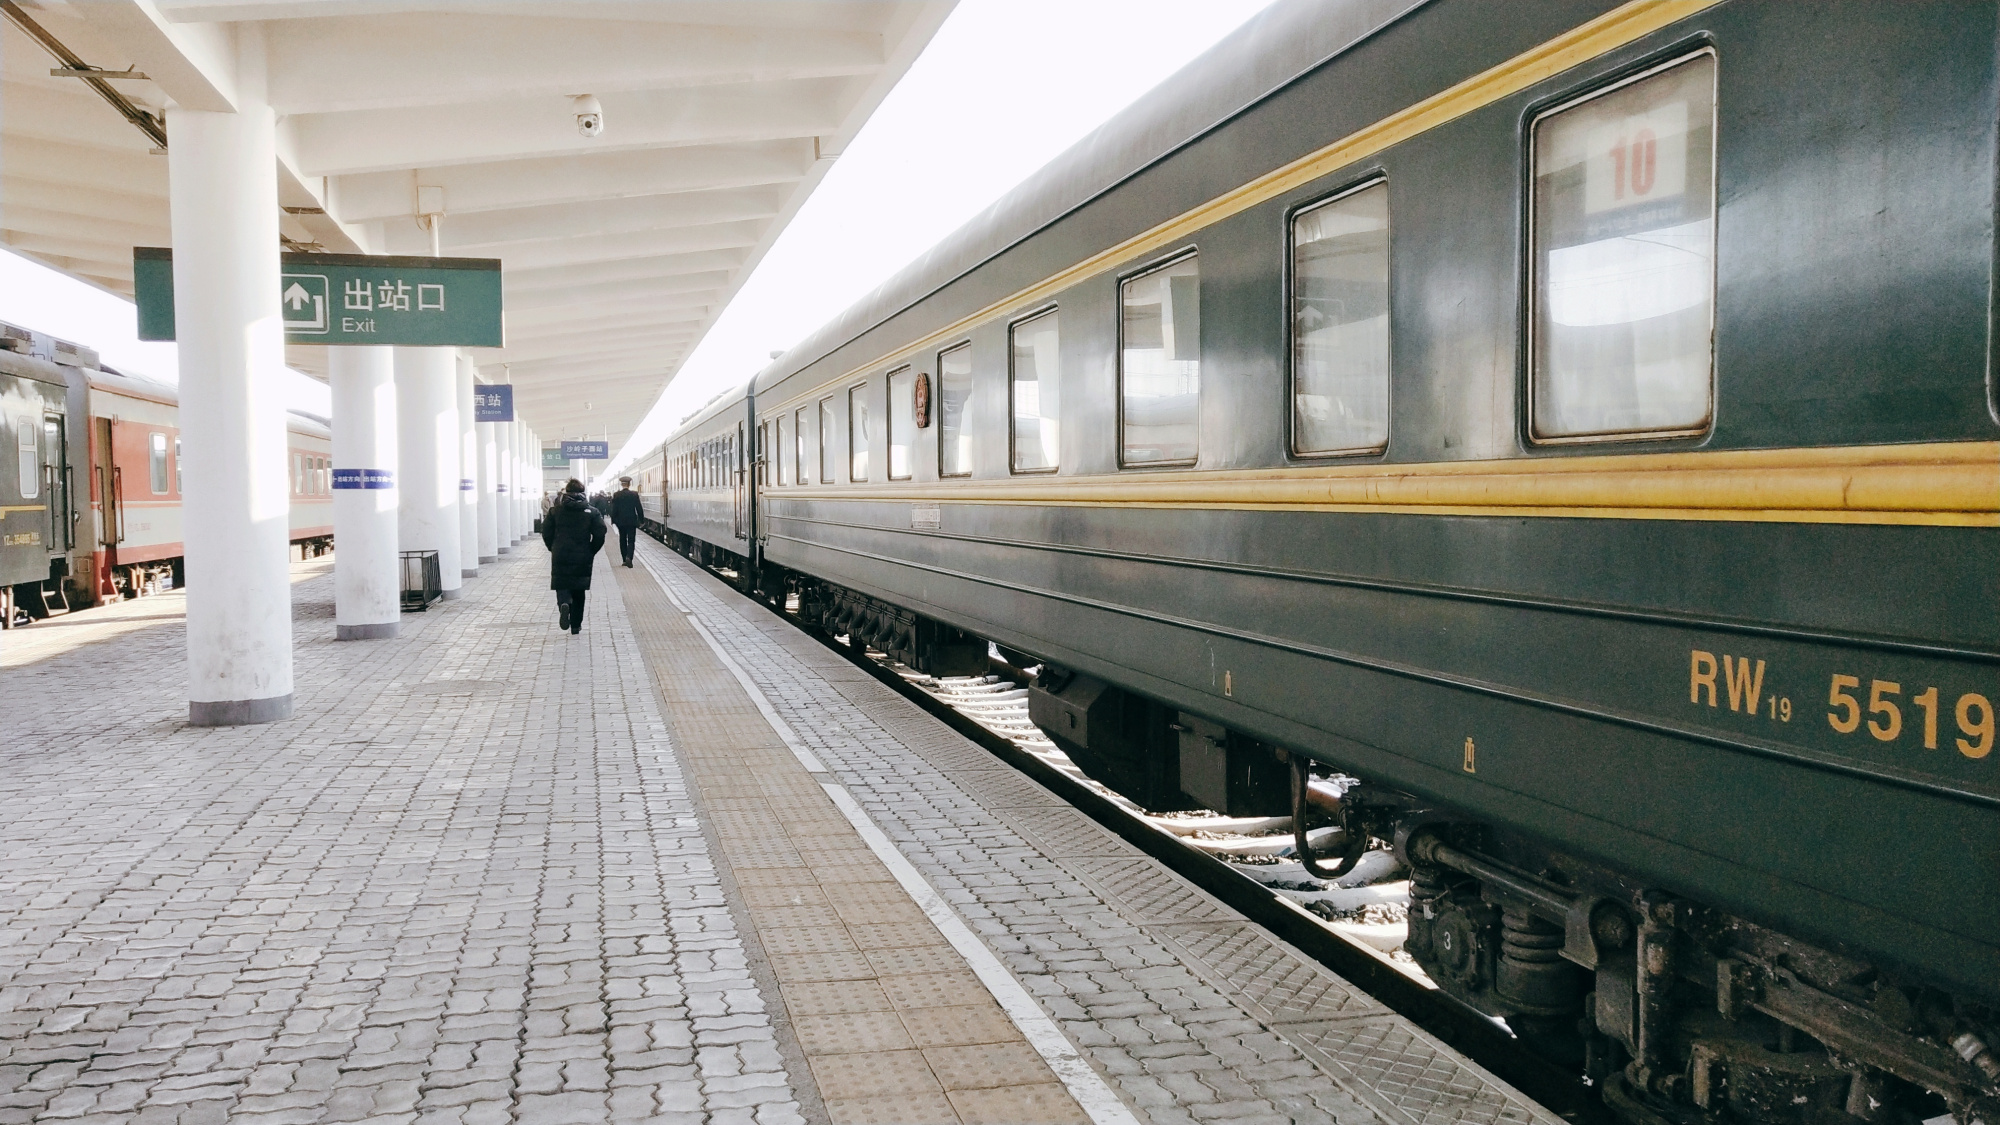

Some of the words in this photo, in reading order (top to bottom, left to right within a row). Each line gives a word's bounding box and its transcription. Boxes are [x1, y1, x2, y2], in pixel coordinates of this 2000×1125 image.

[1608, 128, 1657, 201] 10
[344, 278, 445, 312] 出站口
[342, 317, 376, 333] Exit
[1827, 673, 1996, 759] 5519
[1444, 931, 1451, 951] 3
